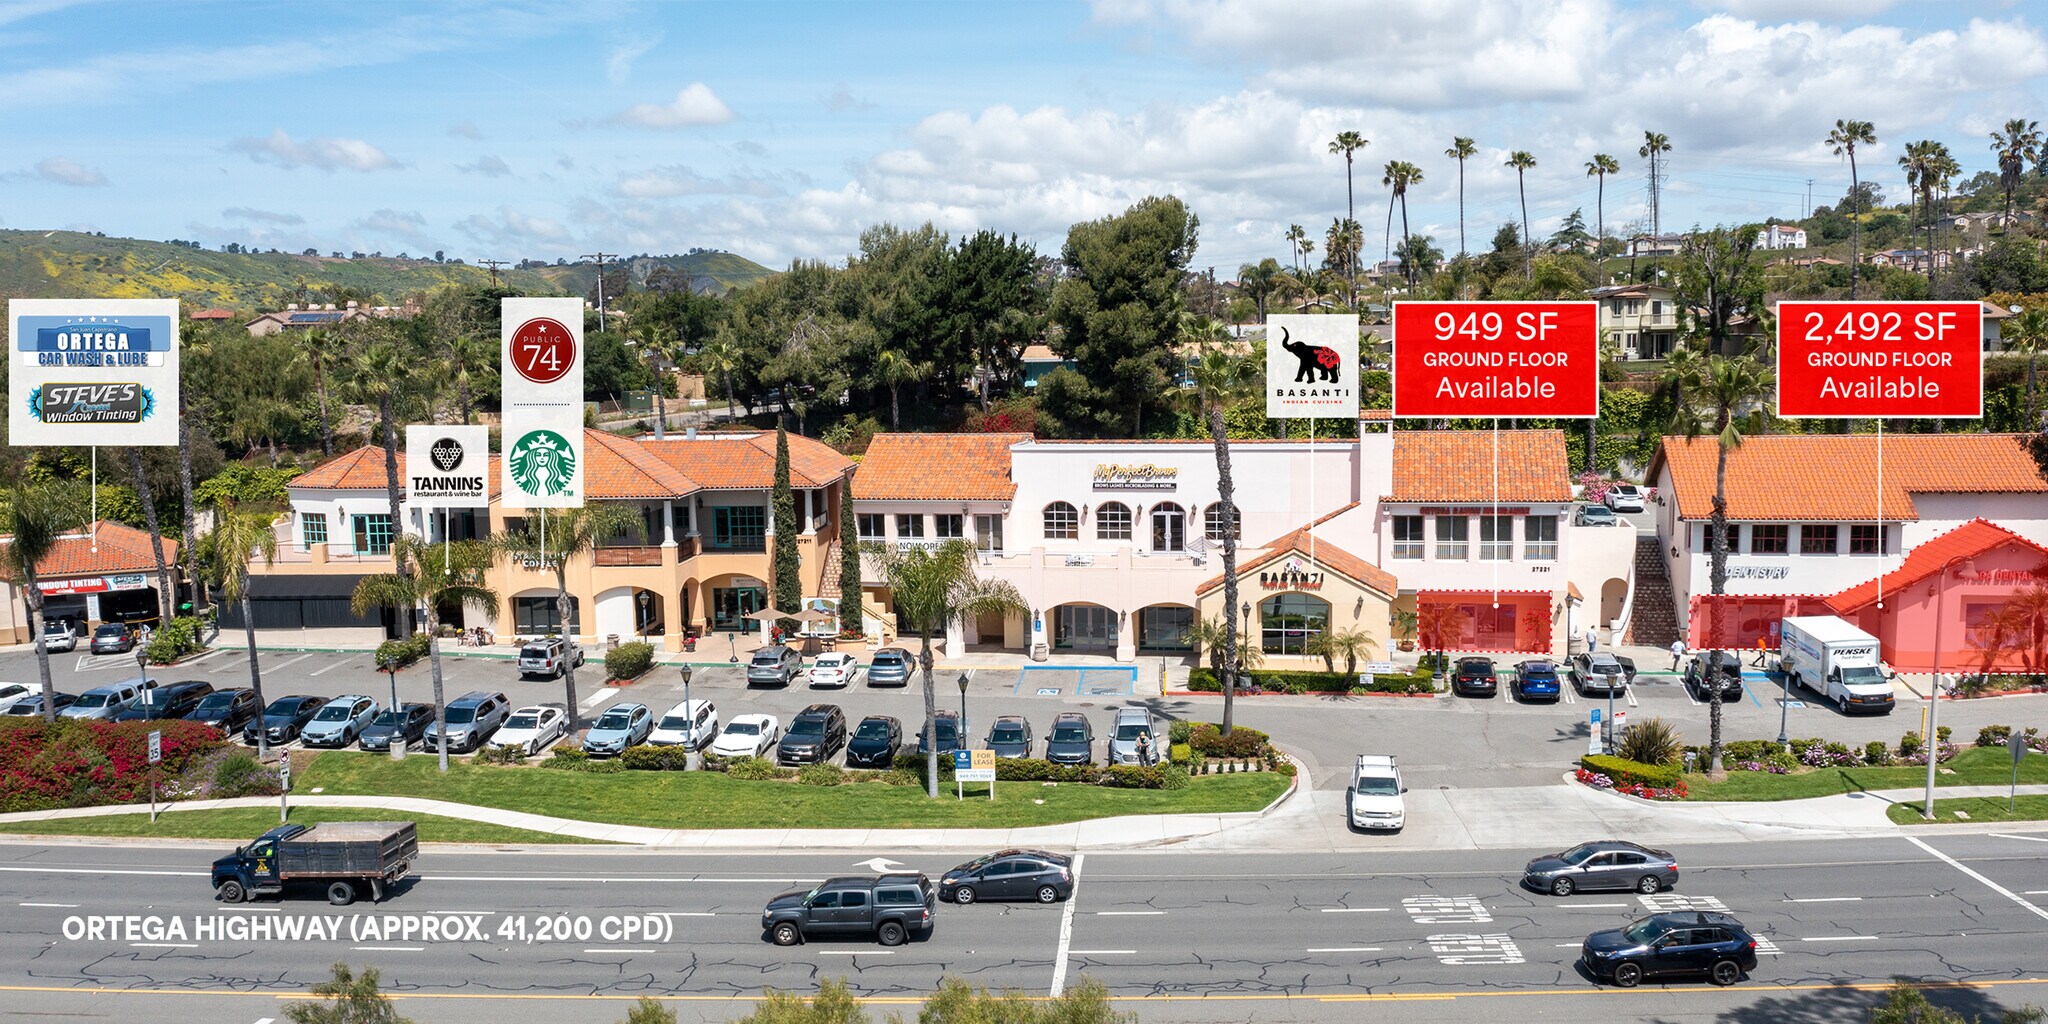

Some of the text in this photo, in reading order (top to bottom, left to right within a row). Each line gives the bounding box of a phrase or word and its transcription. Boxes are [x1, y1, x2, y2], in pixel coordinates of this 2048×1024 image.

[1725, 567, 1789, 578] DENTISTRY
[69, 578, 102, 588] TINTING
[1833, 647, 1873, 656] PENSKE
[150, 747, 159, 759] 35
